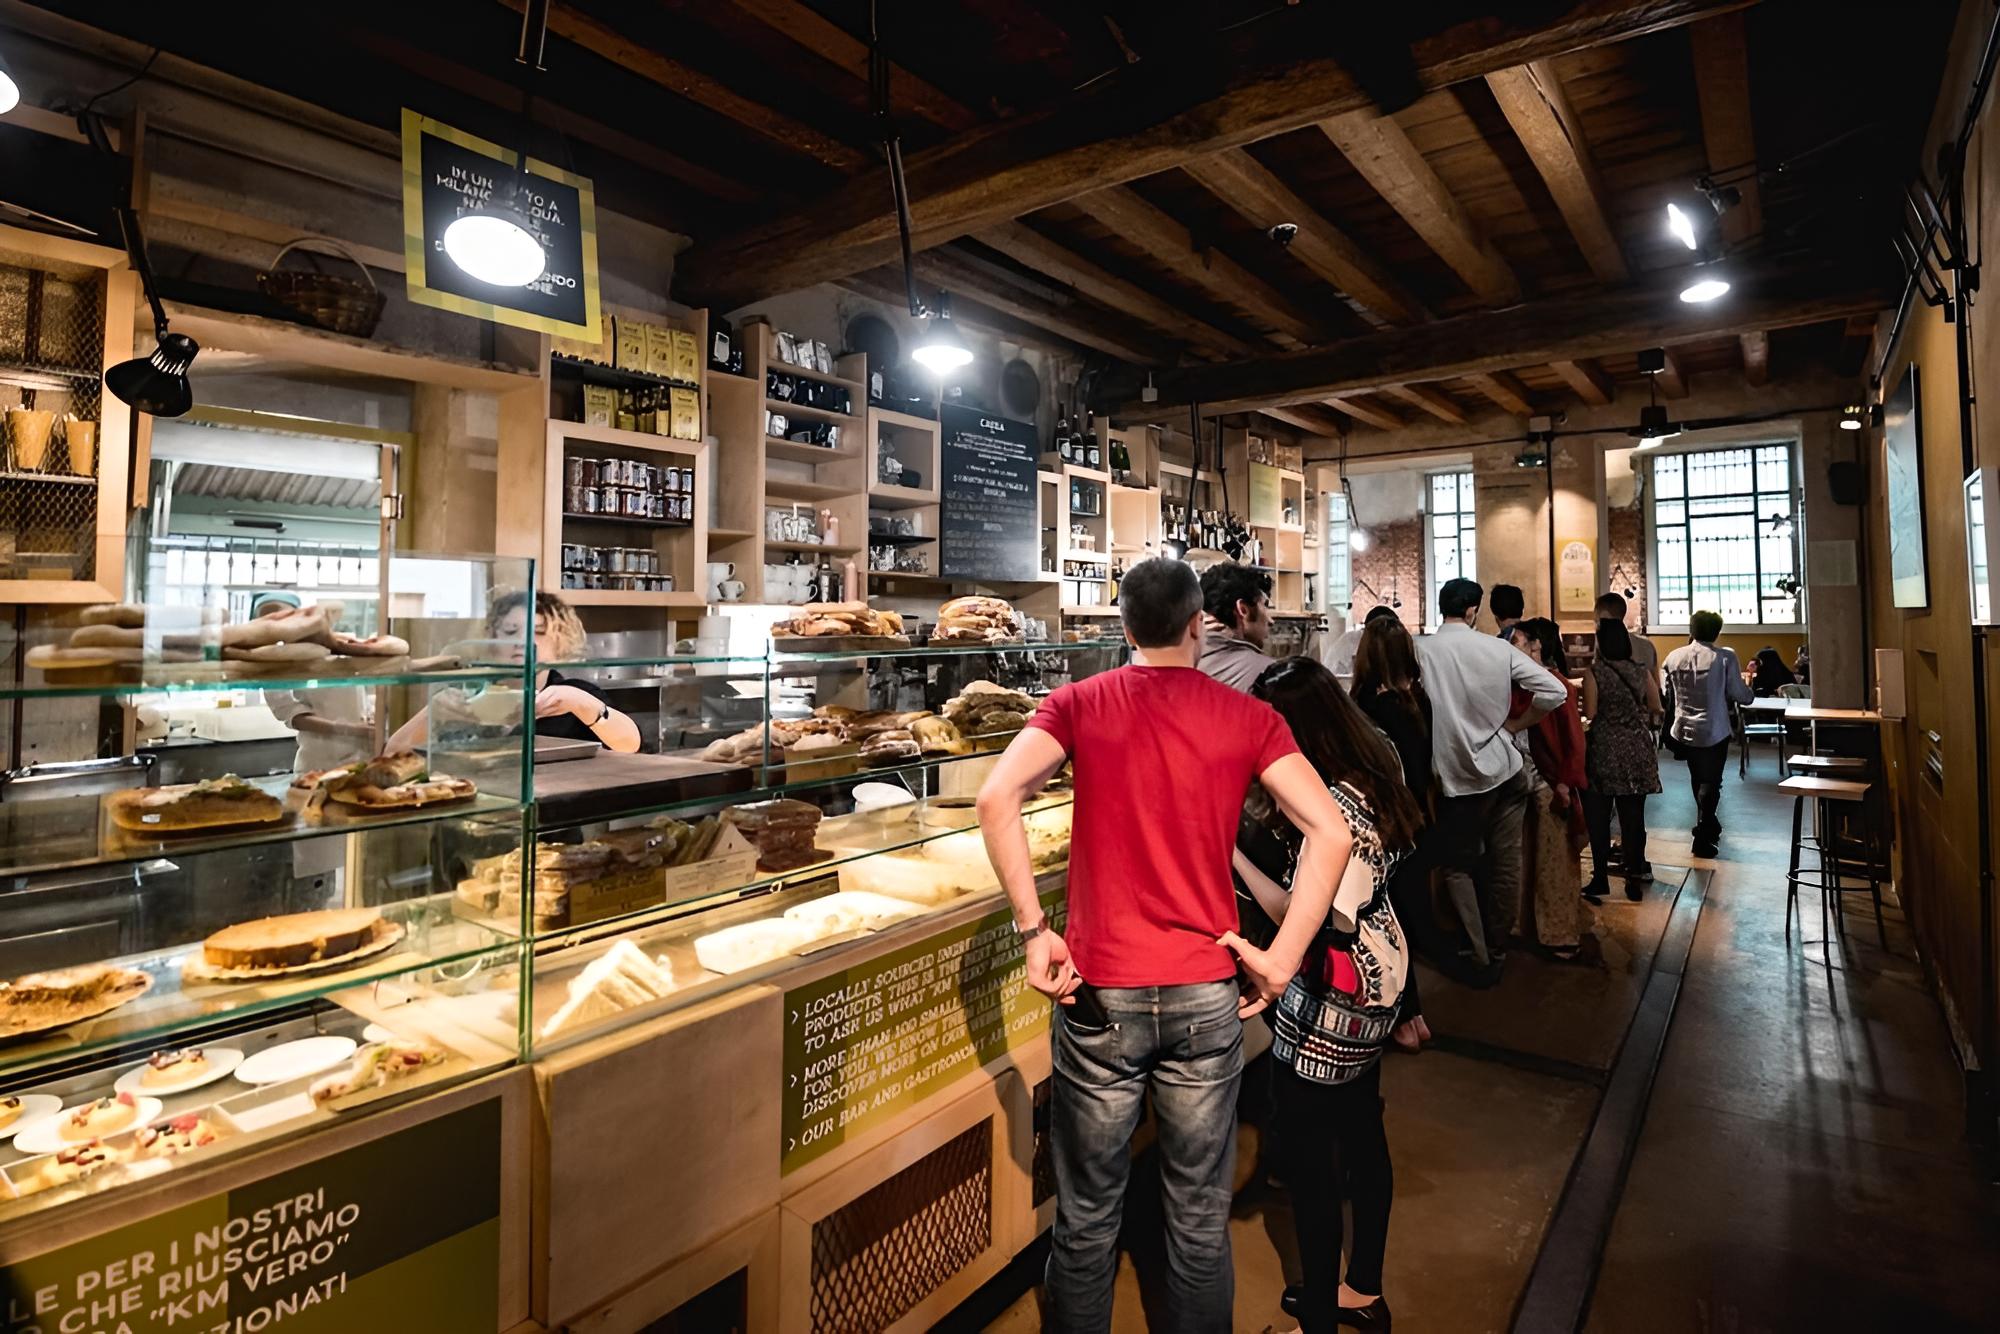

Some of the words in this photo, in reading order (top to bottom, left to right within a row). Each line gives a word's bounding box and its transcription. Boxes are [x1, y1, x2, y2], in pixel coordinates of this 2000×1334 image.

[804, 978, 871, 1018] LOCALLY
[874, 954, 934, 990] SOURCED
[804, 1034, 826, 1054] TO
[830, 1018, 860, 1043] ASK
[865, 1007, 883, 1027] US
[888, 988, 926, 1016] WHAT
[888, 971, 921, 999] THIS
[922, 968, 935, 986] IS
[939, 956, 963, 979] THE
[802, 1069, 878, 1119] DISCOVER
[880, 1048, 918, 1078] MORE
[920, 1036, 939, 1059] ON
[941, 1024, 966, 1047] OUR
[802, 1118, 834, 1146] OUR
[839, 1100, 869, 1128] BAR
[871, 1082, 901, 1109] AND
[1012, 1010, 1039, 1032] OPEN
[803, 1050, 847, 1083] MORE
[850, 1029, 891, 1060] THAN
[895, 1017, 917, 1038] 100
[920, 997, 961, 1025] SMALL
[803, 1074, 833, 1100] FOR
[874, 1042, 897, 1065] WE
[900, 1022, 938, 1053] KNOW
[977, 994, 997, 1014] ALL
[59, 1285, 144, 1333] CHE
[159, 1203, 360, 1299] RIUSCIAMO
[76, 1250, 155, 1300] PER
[170, 1240, 178, 1265] I
[194, 1186, 325, 1257] NOSTRI
[150, 1279, 229, 1326] "KM
[242, 1232, 350, 1292] VERO"
